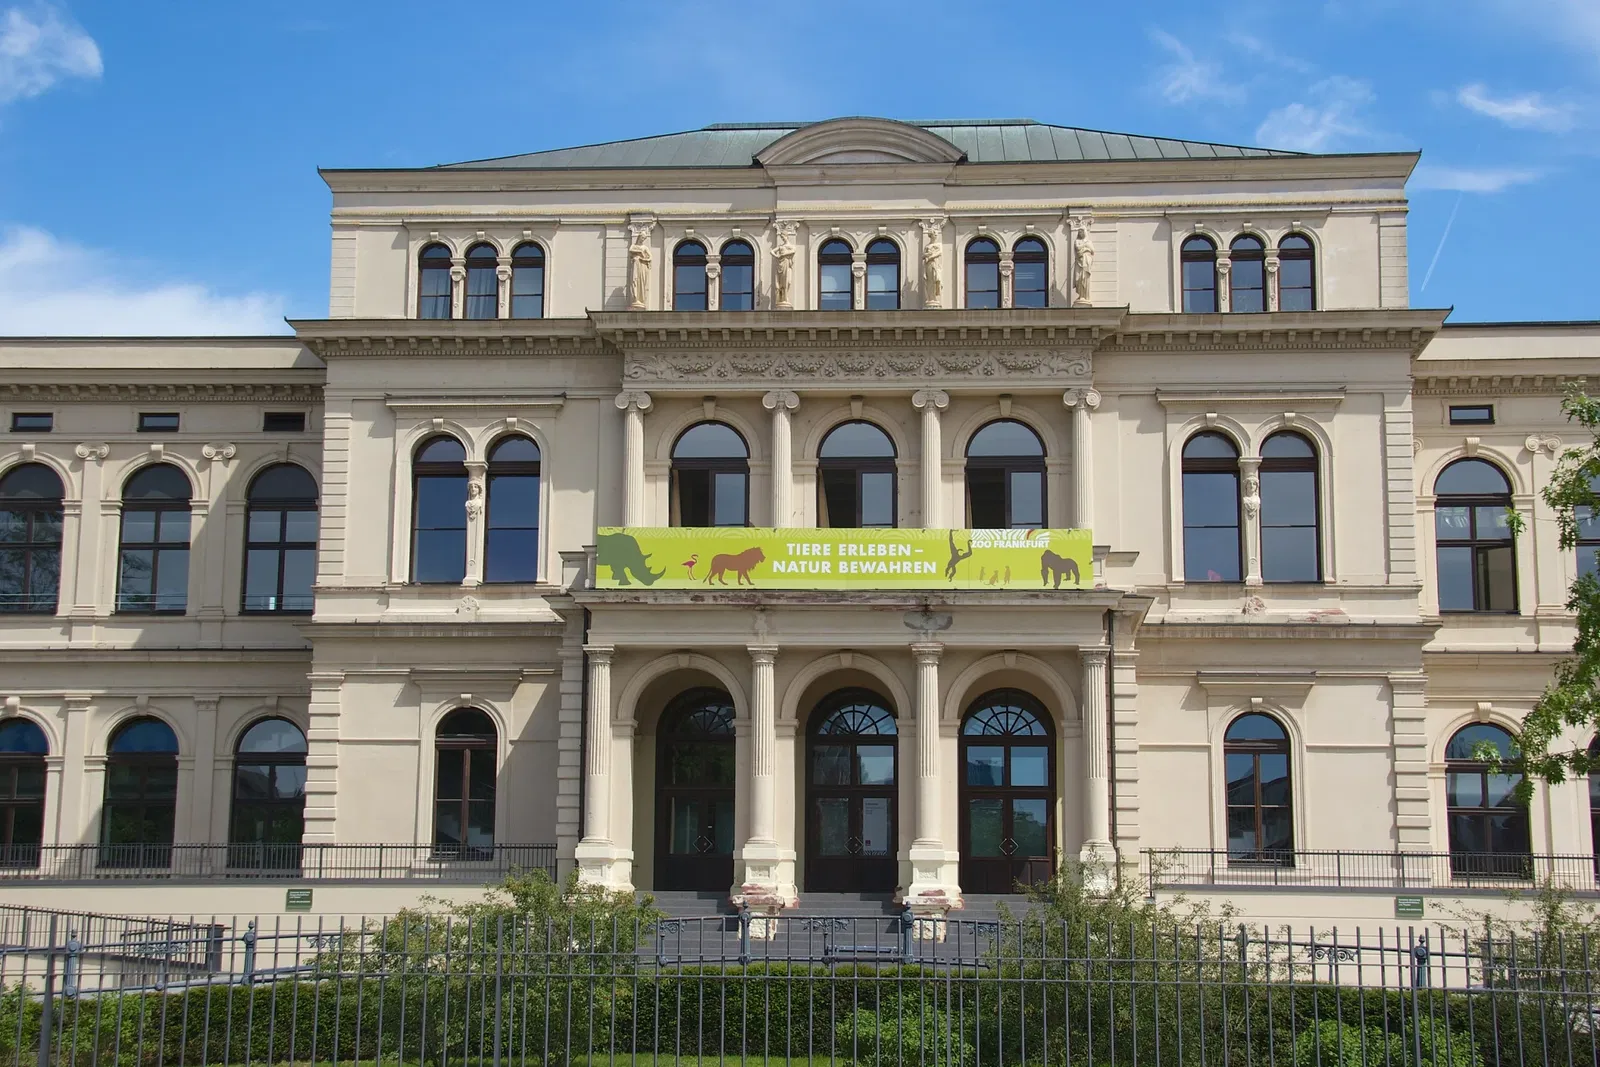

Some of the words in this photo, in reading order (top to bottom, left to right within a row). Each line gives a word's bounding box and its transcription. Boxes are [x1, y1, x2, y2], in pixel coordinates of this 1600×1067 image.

[786, 543, 831, 556] TIERE
[971, 540, 992, 549] ZOO
[994, 540, 1050, 549] FRANKFURT
[772, 560, 832, 574] NATUR
[838, 561, 937, 574] BEWAHREN
